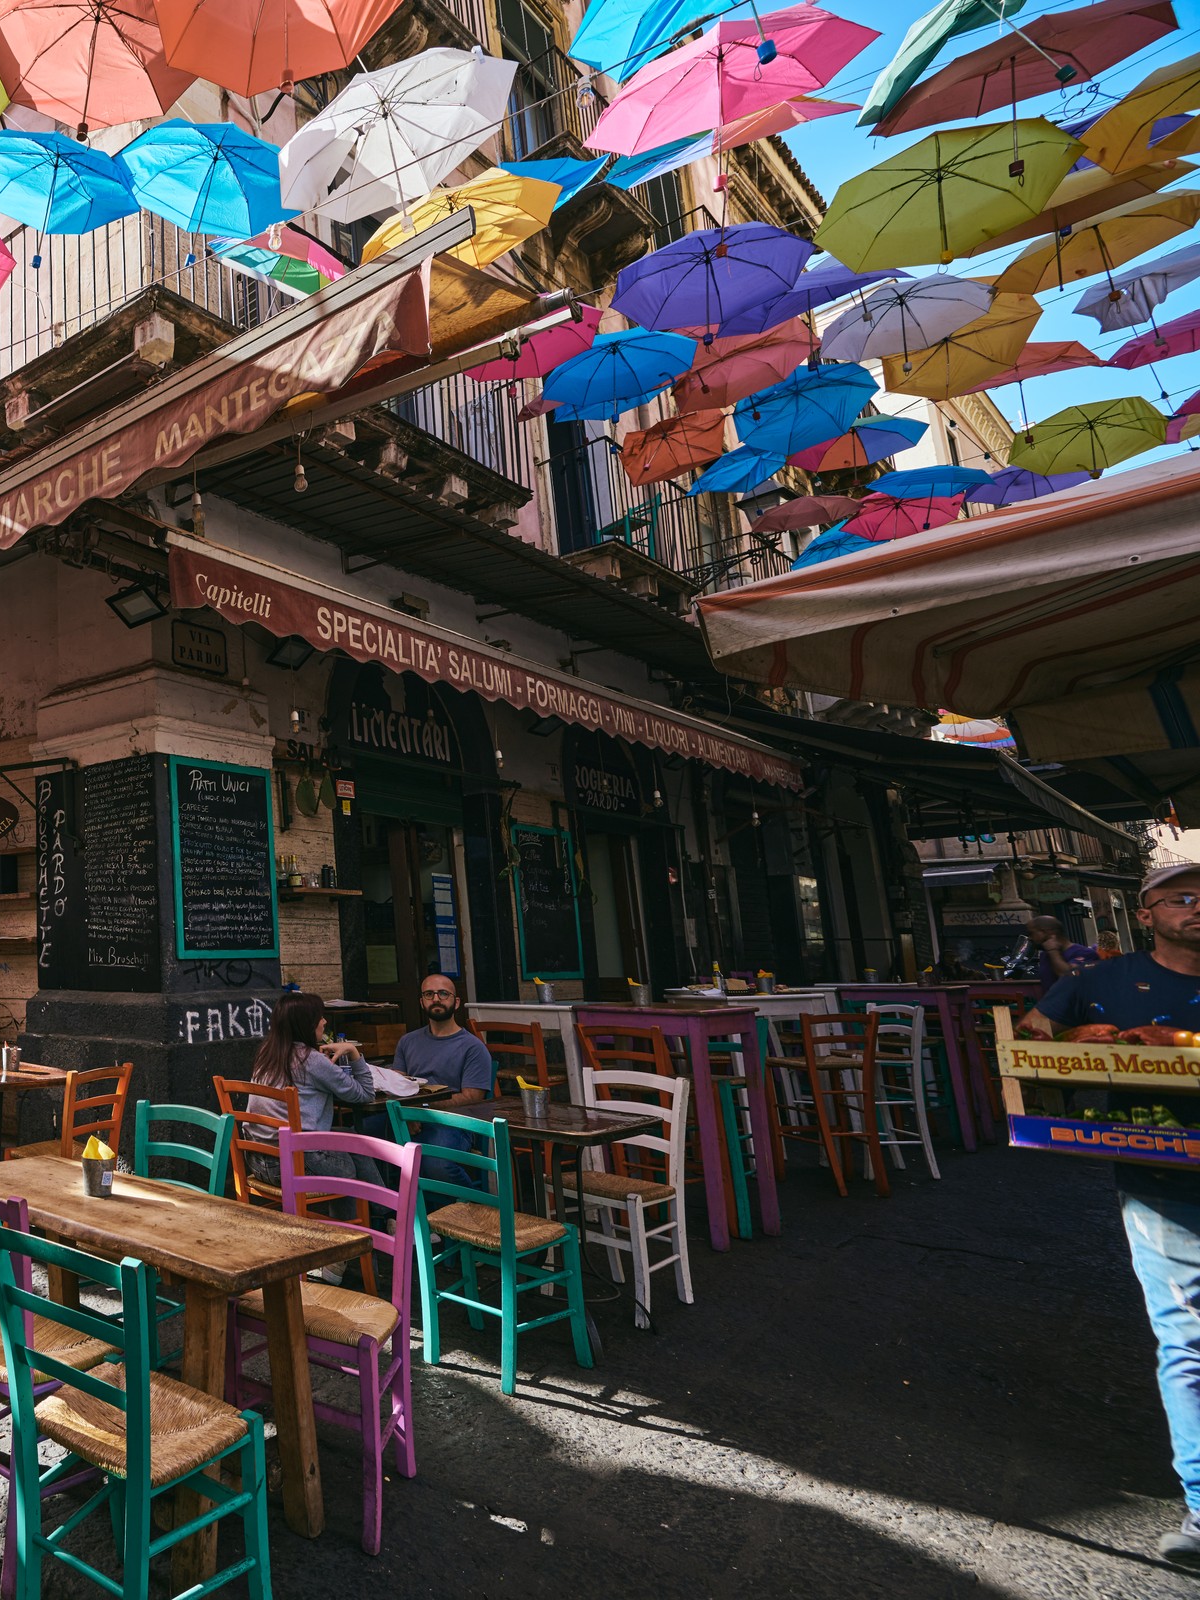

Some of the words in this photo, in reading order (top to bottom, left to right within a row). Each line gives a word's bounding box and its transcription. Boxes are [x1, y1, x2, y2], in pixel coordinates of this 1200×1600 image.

[189, 630, 210, 646] VIA
[179, 645, 221, 667] PARDO
[196, 574, 272, 619] Capitelli
[448, 650, 513, 697] SALUMI
[526, 676, 603, 726] FORMAGGI
[610, 705, 636, 736] VINI
[644, 720, 689, 752] LIQUORI
[697, 735, 751, 771] ALIMENTARI
[586, 790, 619, 811] PARDO
[89, 948, 103, 963] Mix
[1011, 1049, 1107, 1075] Fungaia
[1110, 1053, 1200, 1077] Mendo
[1112, 1126, 1146, 1134] AZIENDA
[1148, 1129, 1188, 1138] AGRICOLA
